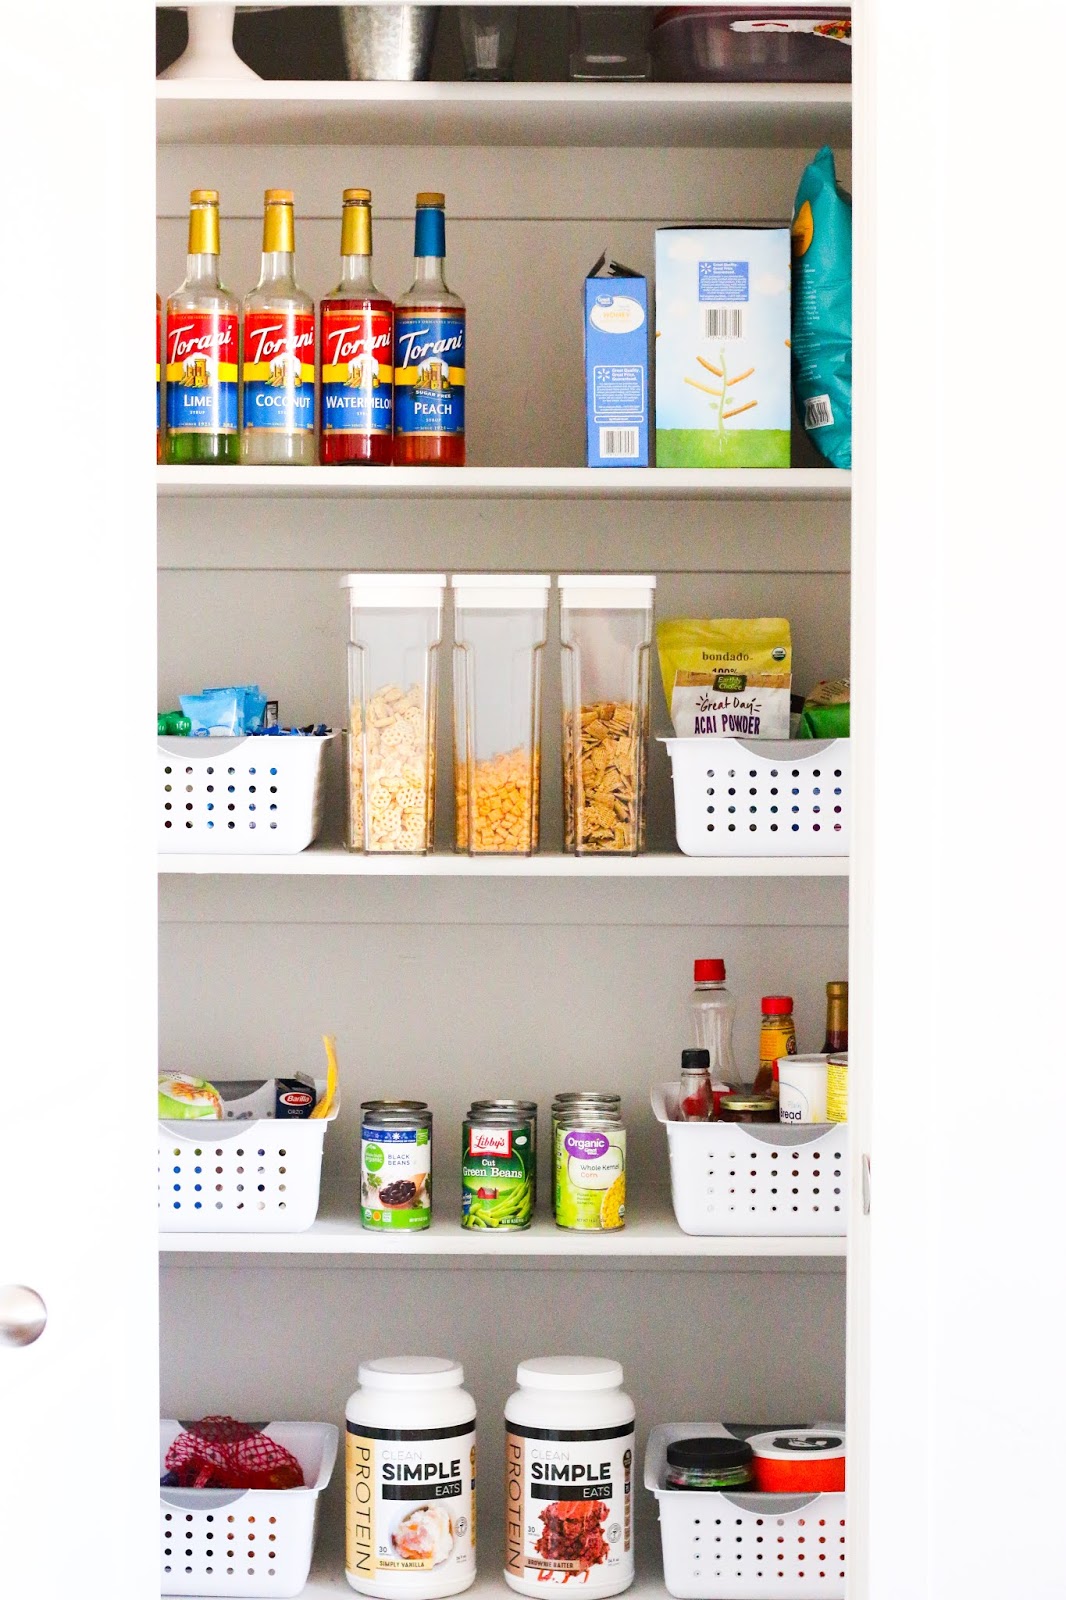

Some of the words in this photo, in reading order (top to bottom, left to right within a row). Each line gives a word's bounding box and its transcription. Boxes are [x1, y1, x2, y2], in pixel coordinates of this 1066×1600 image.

[169, 324, 232, 364] Torani
[250, 324, 314, 365] Torani
[328, 325, 391, 366] Torani
[399, 328, 463, 369] Torani
[184, 394, 213, 407] LIME
[255, 394, 311, 408] COCONUT
[414, 402, 452, 415] PEACH
[702, 652, 750, 661] bondado
[718, 683, 742, 691] Choice
[700, 696, 731, 712] Great
[733, 697, 754, 715] Day
[694, 715, 717, 734] ACAI
[721, 714, 761, 735] POWDER
[286, 1095, 310, 1103] Barilla
[473, 1135, 505, 1149] Libby's
[567, 1137, 605, 1150] Organic
[481, 1159, 496, 1167] Cut
[463, 1166, 488, 1176] Green
[490, 1167, 523, 1178] Beans
[382, 1450, 423, 1461] CLEAN
[531, 1449, 570, 1461] CLEAN
[382, 1459, 461, 1481] SIMPLE
[531, 1462, 612, 1482] SIMPLE
[435, 1482, 461, 1496] EATS
[583, 1486, 611, 1498] EATS
[355, 1446, 371, 1571] PROTEIN
[508, 1444, 522, 1569] PROTEIN
[379, 1560, 400, 1568] SIMPLY
[527, 1558, 552, 1568] BROWNIE
